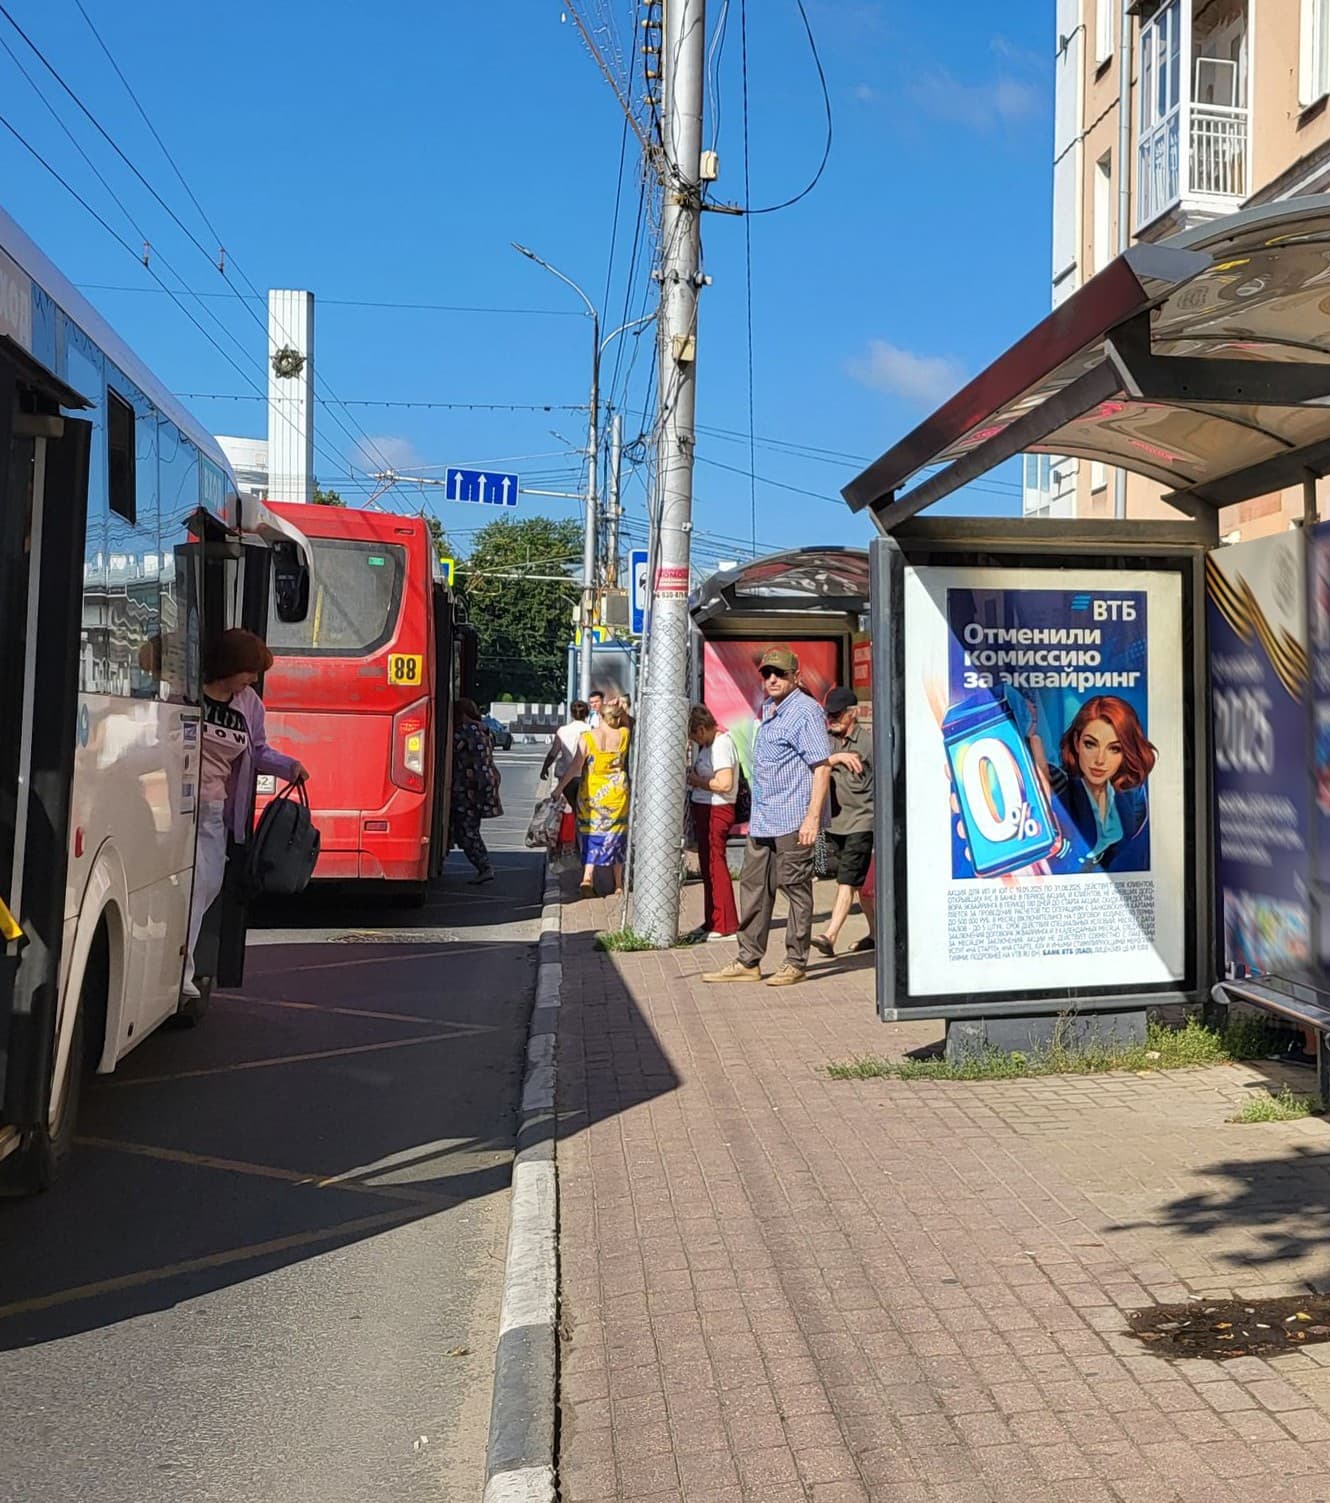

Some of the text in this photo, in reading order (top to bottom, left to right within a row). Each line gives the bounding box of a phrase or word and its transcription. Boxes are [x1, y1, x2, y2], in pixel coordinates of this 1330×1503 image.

[1093, 600, 1137, 621] ВТБ
[963, 623, 1101, 645] Отменили
[394, 657, 416, 680] 88
[963, 650, 1101, 667] комиссию
[963, 667, 1141, 693] за эквайринг
